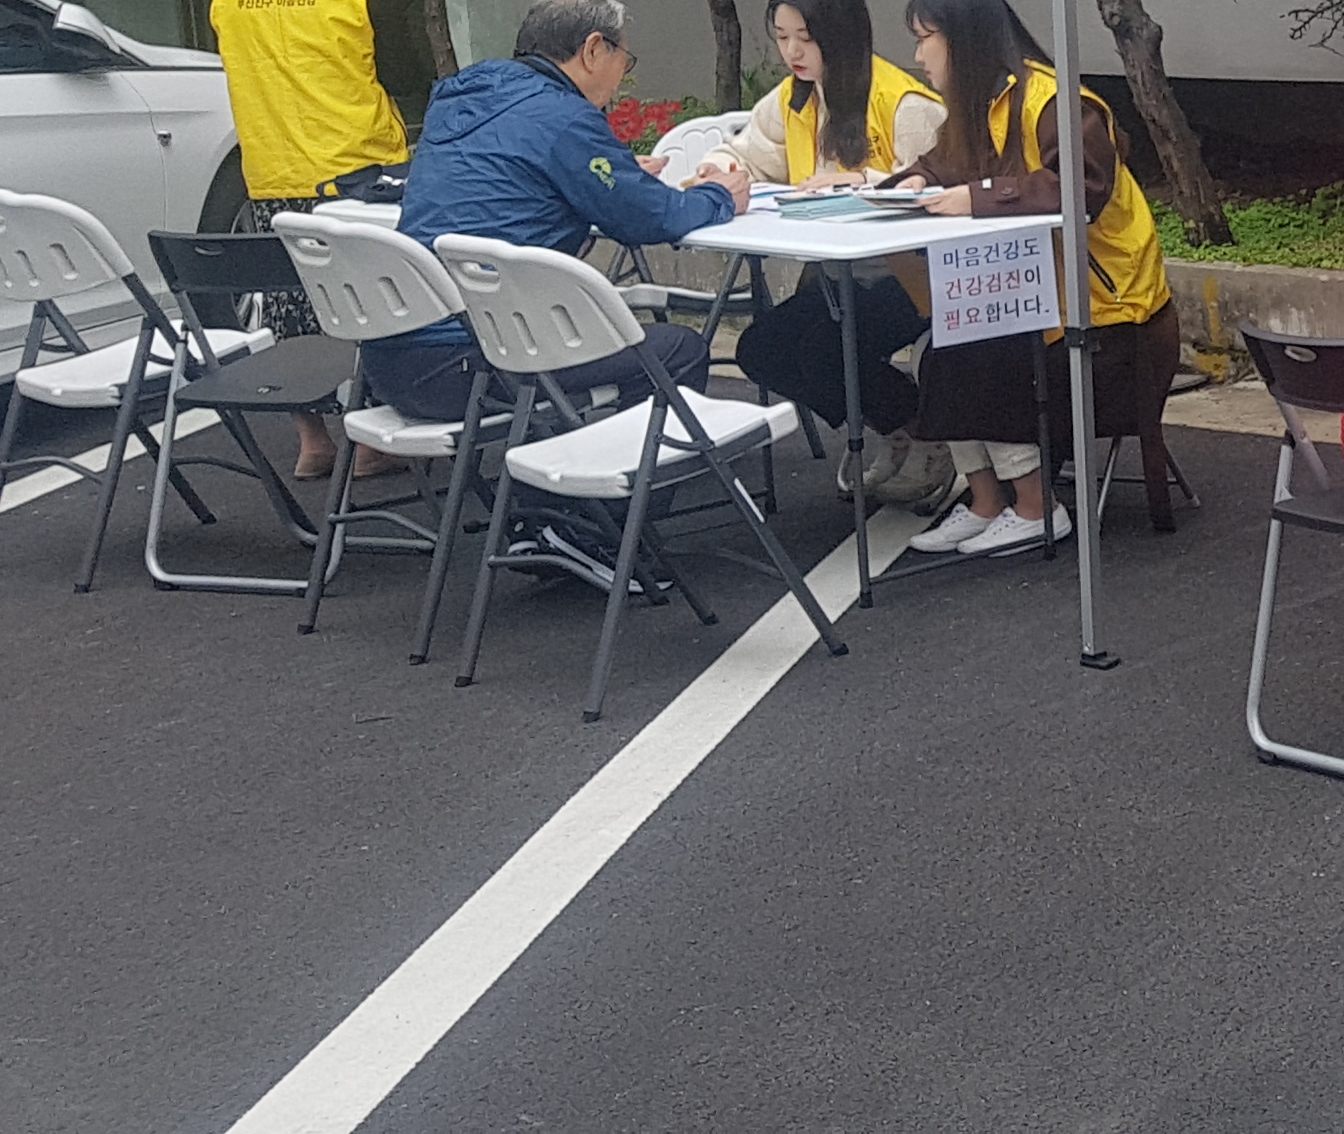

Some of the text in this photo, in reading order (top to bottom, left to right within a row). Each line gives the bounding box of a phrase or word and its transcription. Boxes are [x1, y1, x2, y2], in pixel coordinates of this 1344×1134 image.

[943, 237, 1041, 269] 마음건강도
[944, 264, 1041, 300] 건강검진이
[943, 294, 1050, 331] 필요합니다.
